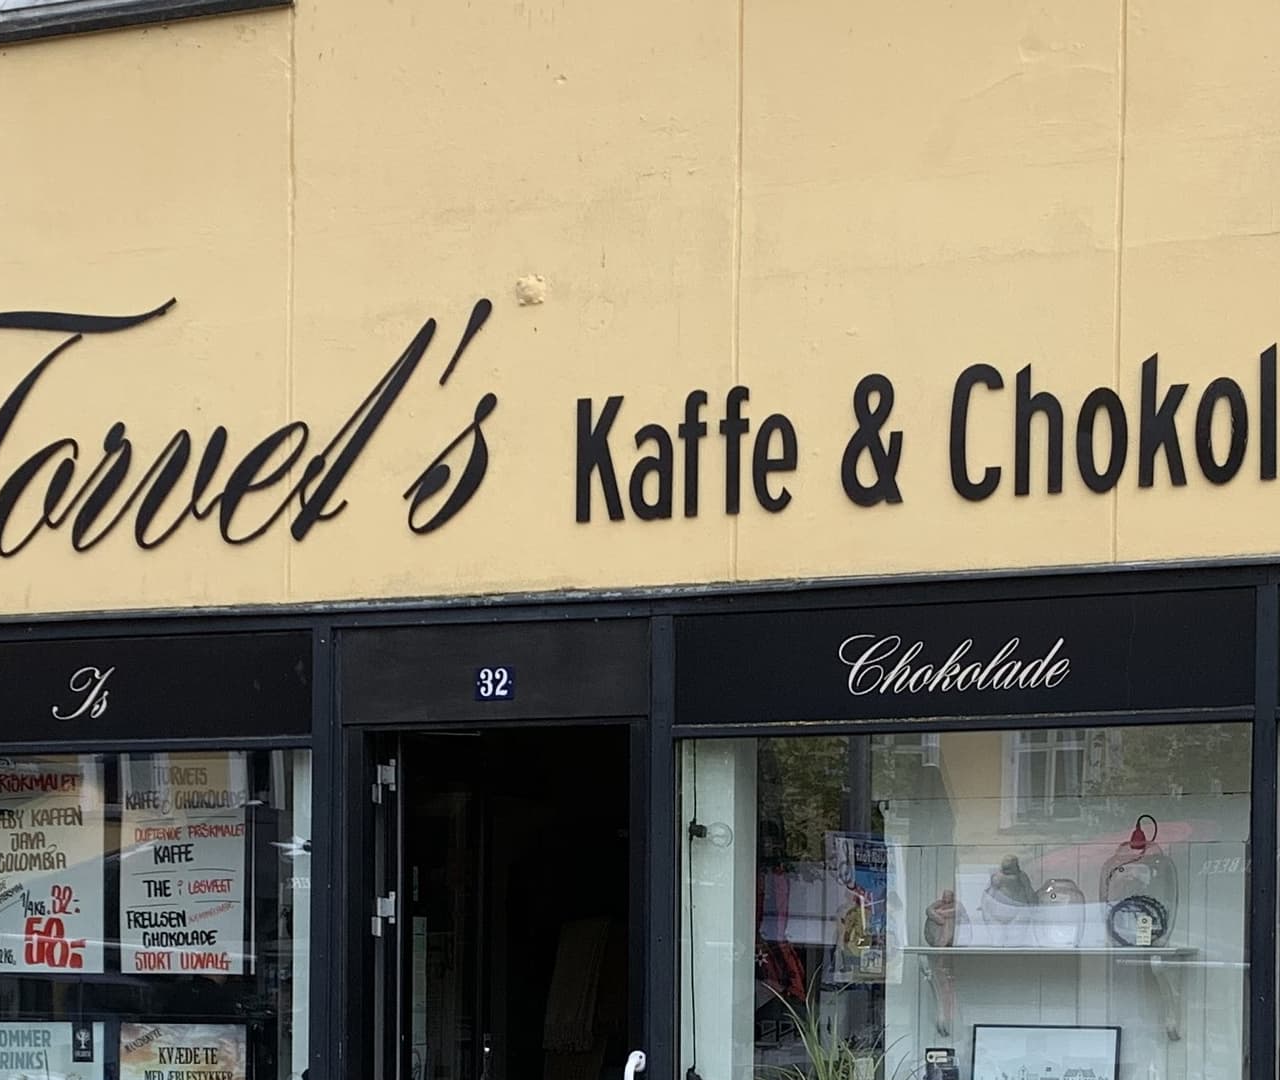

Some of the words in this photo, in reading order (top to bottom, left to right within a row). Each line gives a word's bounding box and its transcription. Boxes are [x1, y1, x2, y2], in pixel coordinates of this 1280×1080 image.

[574, 385, 800, 524] Kaffe
[840, 372, 905, 508] &
[838, 634, 1072, 696] Chokolade
[478, 667, 509, 697] 32
[52, 666, 115, 721] Is
[10, 831, 46, 852] JAVA
[154, 843, 194, 864] KAFFE
[143, 880, 171, 898] THE
[135, 952, 173, 970] STORT
[181, 952, 232, 970] UDVALG
[158, 1047, 200, 1064] KVÆDE
[202, 1047, 218, 1065] TE
